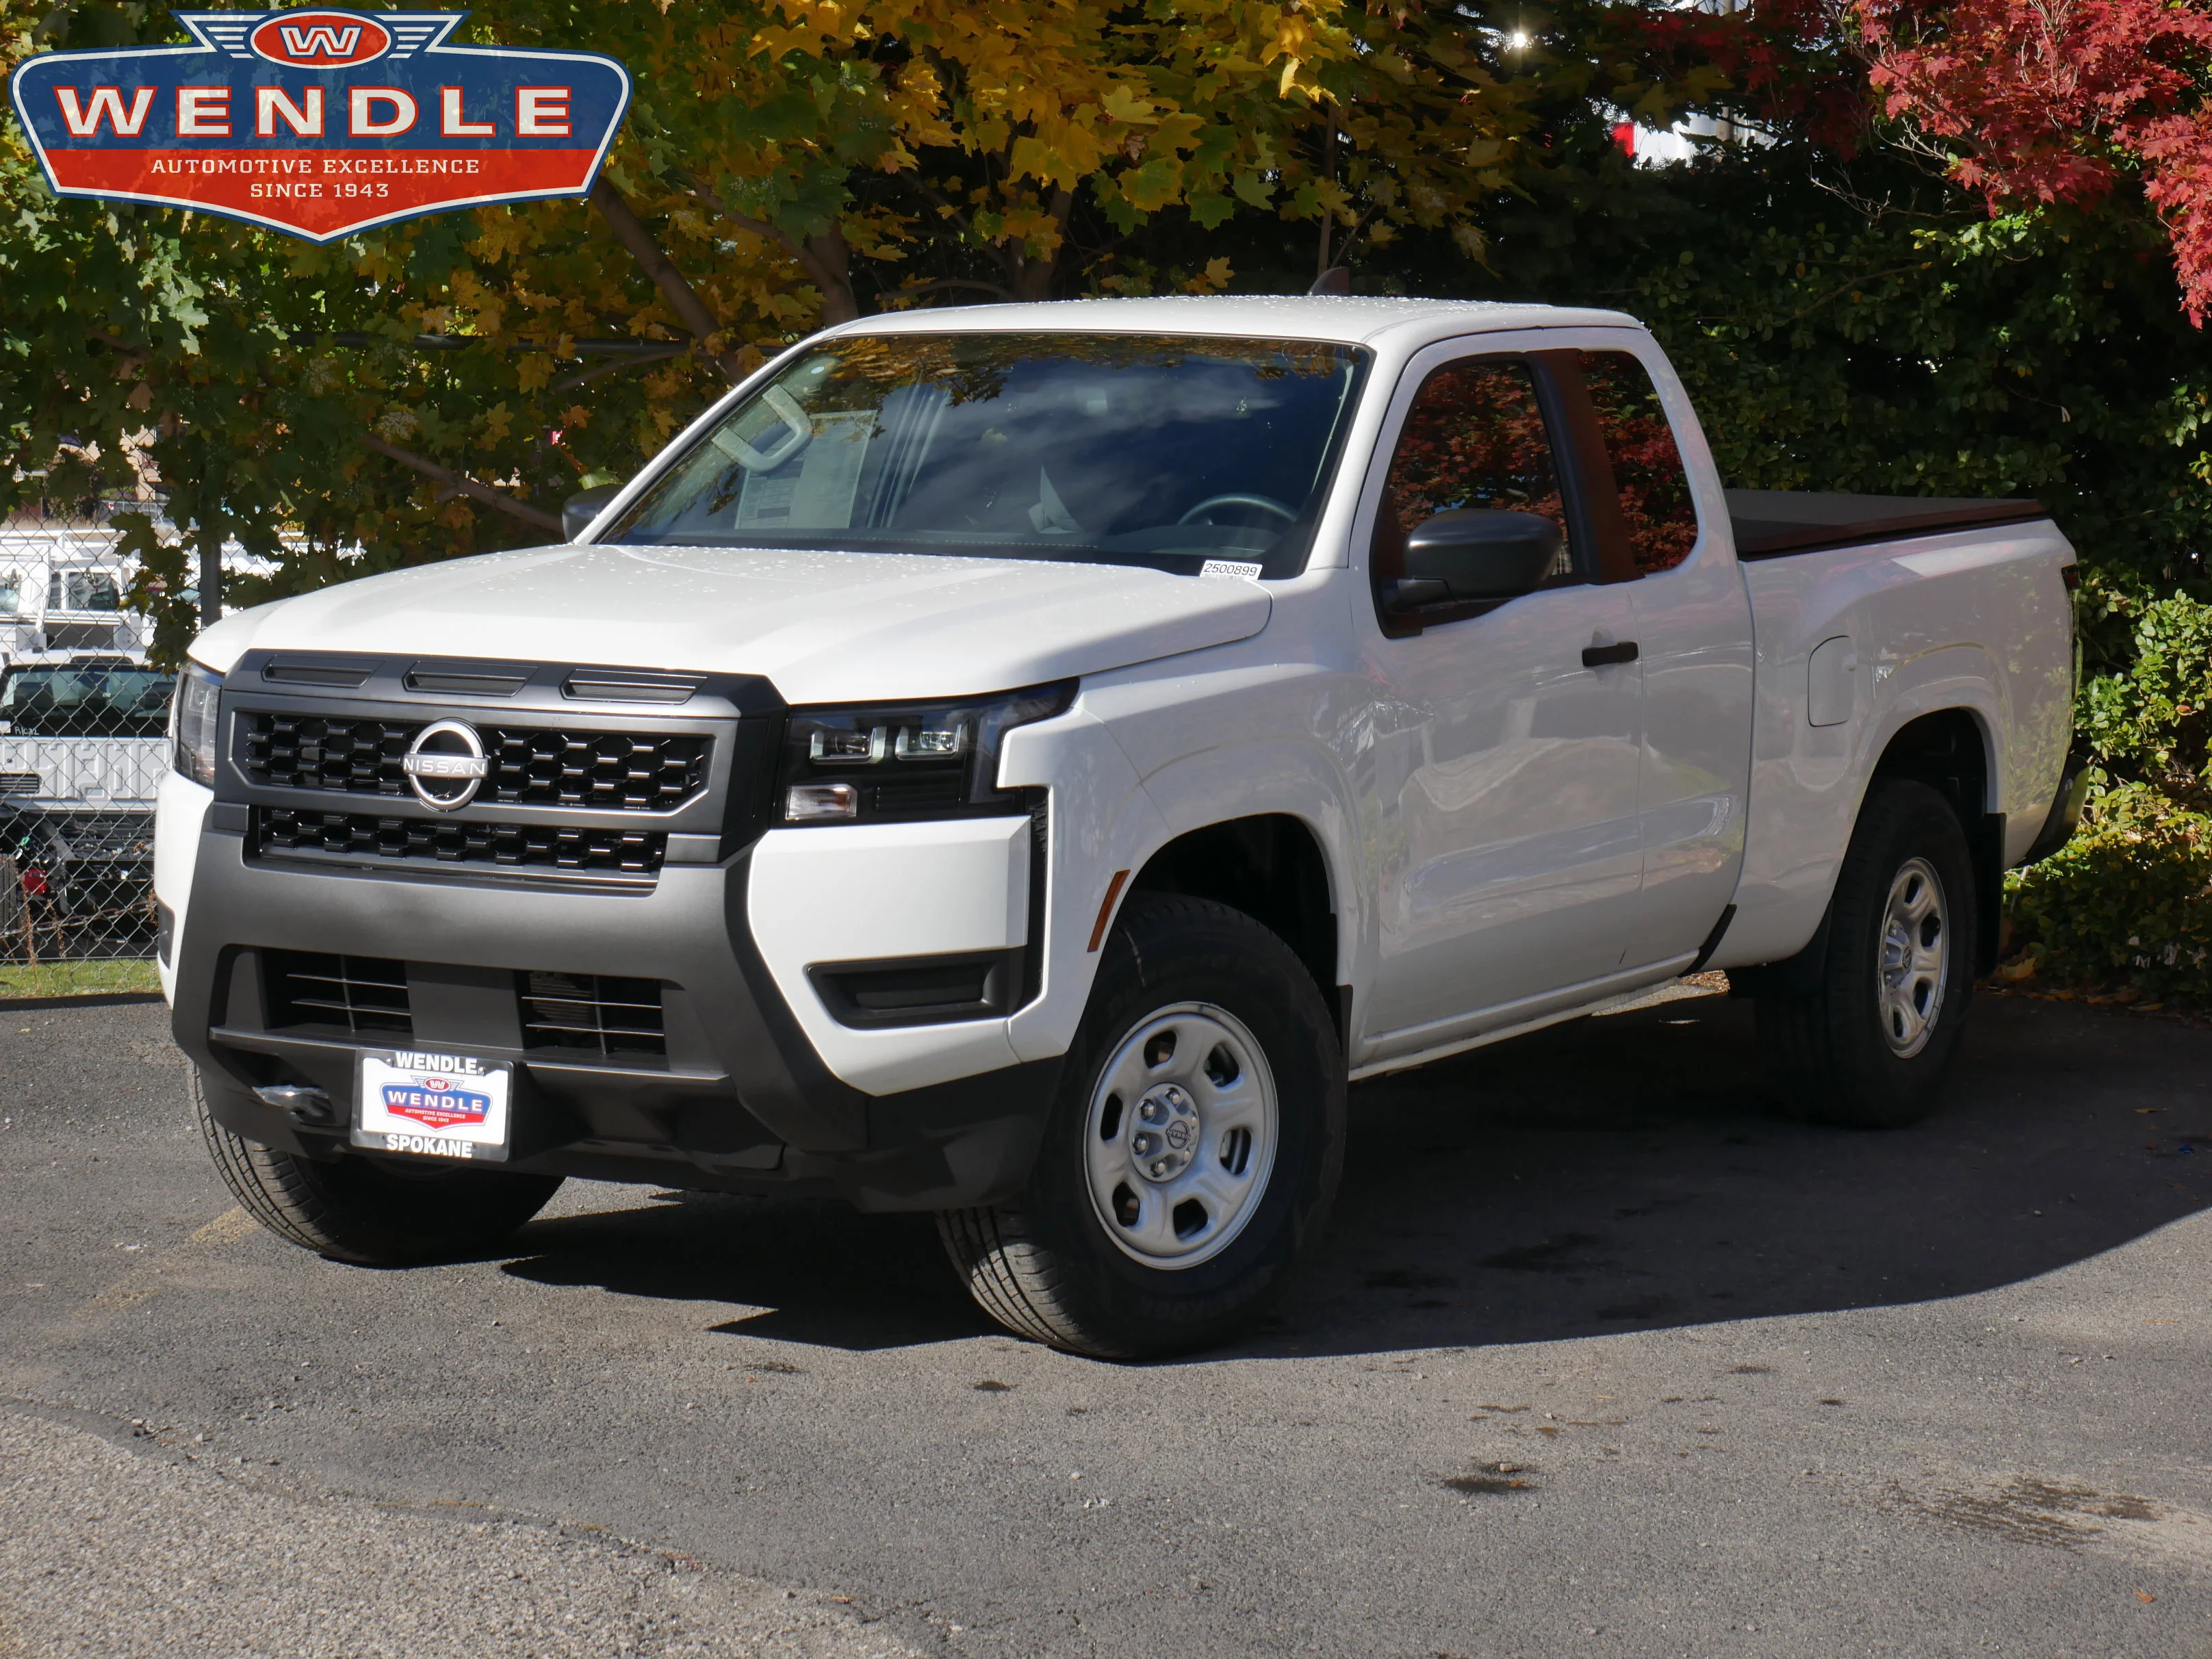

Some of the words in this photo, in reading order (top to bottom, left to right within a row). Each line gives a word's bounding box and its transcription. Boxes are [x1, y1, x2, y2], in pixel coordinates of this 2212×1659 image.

[1204, 563, 1257, 576] 2500899
[404, 758, 485, 775] NISSAN
[395, 1051, 478, 1075] WENDLE
[387, 1090, 483, 1111] WENDLE
[405, 1108, 436, 1116] AUTOMOTIVE
[387, 1133, 472, 1158] SPOKANE
